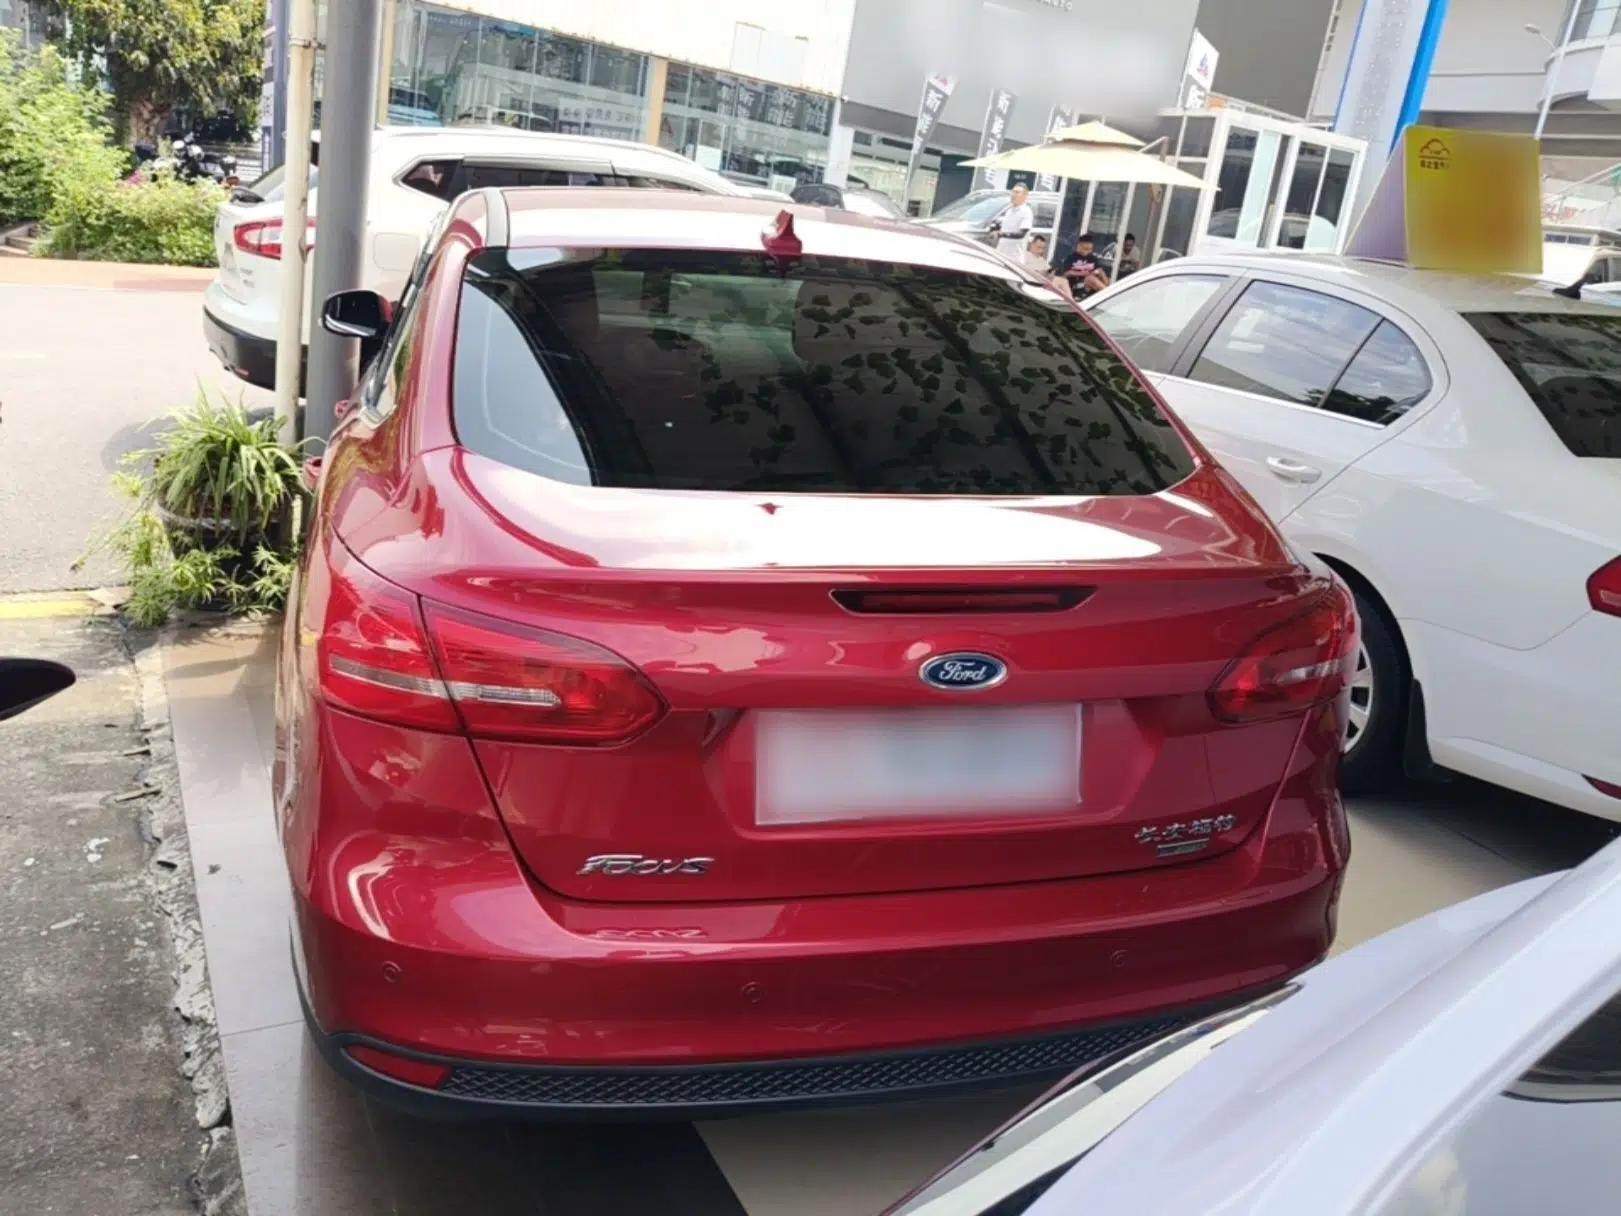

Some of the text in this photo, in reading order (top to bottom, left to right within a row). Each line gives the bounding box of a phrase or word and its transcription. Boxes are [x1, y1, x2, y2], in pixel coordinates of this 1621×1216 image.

[939, 660, 988, 681] Ford
[1134, 813, 1236, 844] 长安福特
